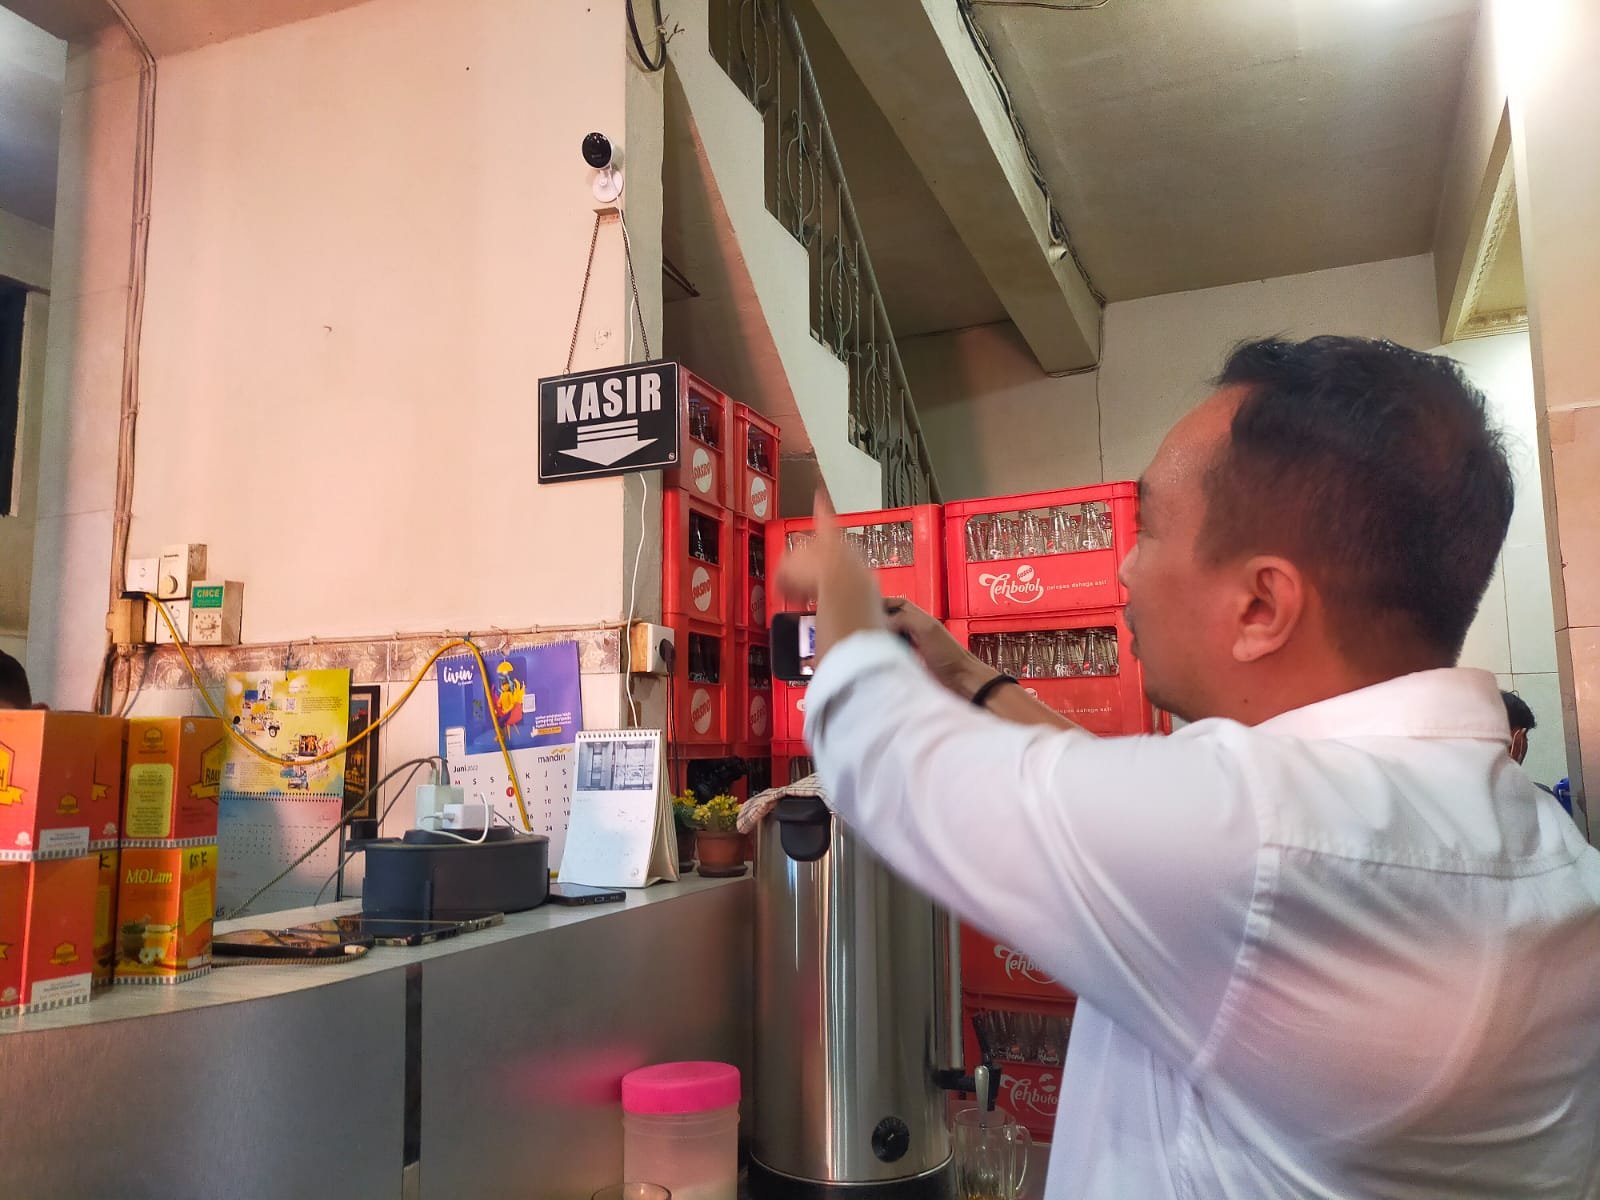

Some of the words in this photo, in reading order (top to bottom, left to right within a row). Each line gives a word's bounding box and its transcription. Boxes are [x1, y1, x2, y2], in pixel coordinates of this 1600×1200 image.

[557, 373, 662, 424] KASIR
[978, 573, 1044, 606] Tehbotol
[538, 753, 566, 763] mandiri
[453, 765, 467, 773] Juni
